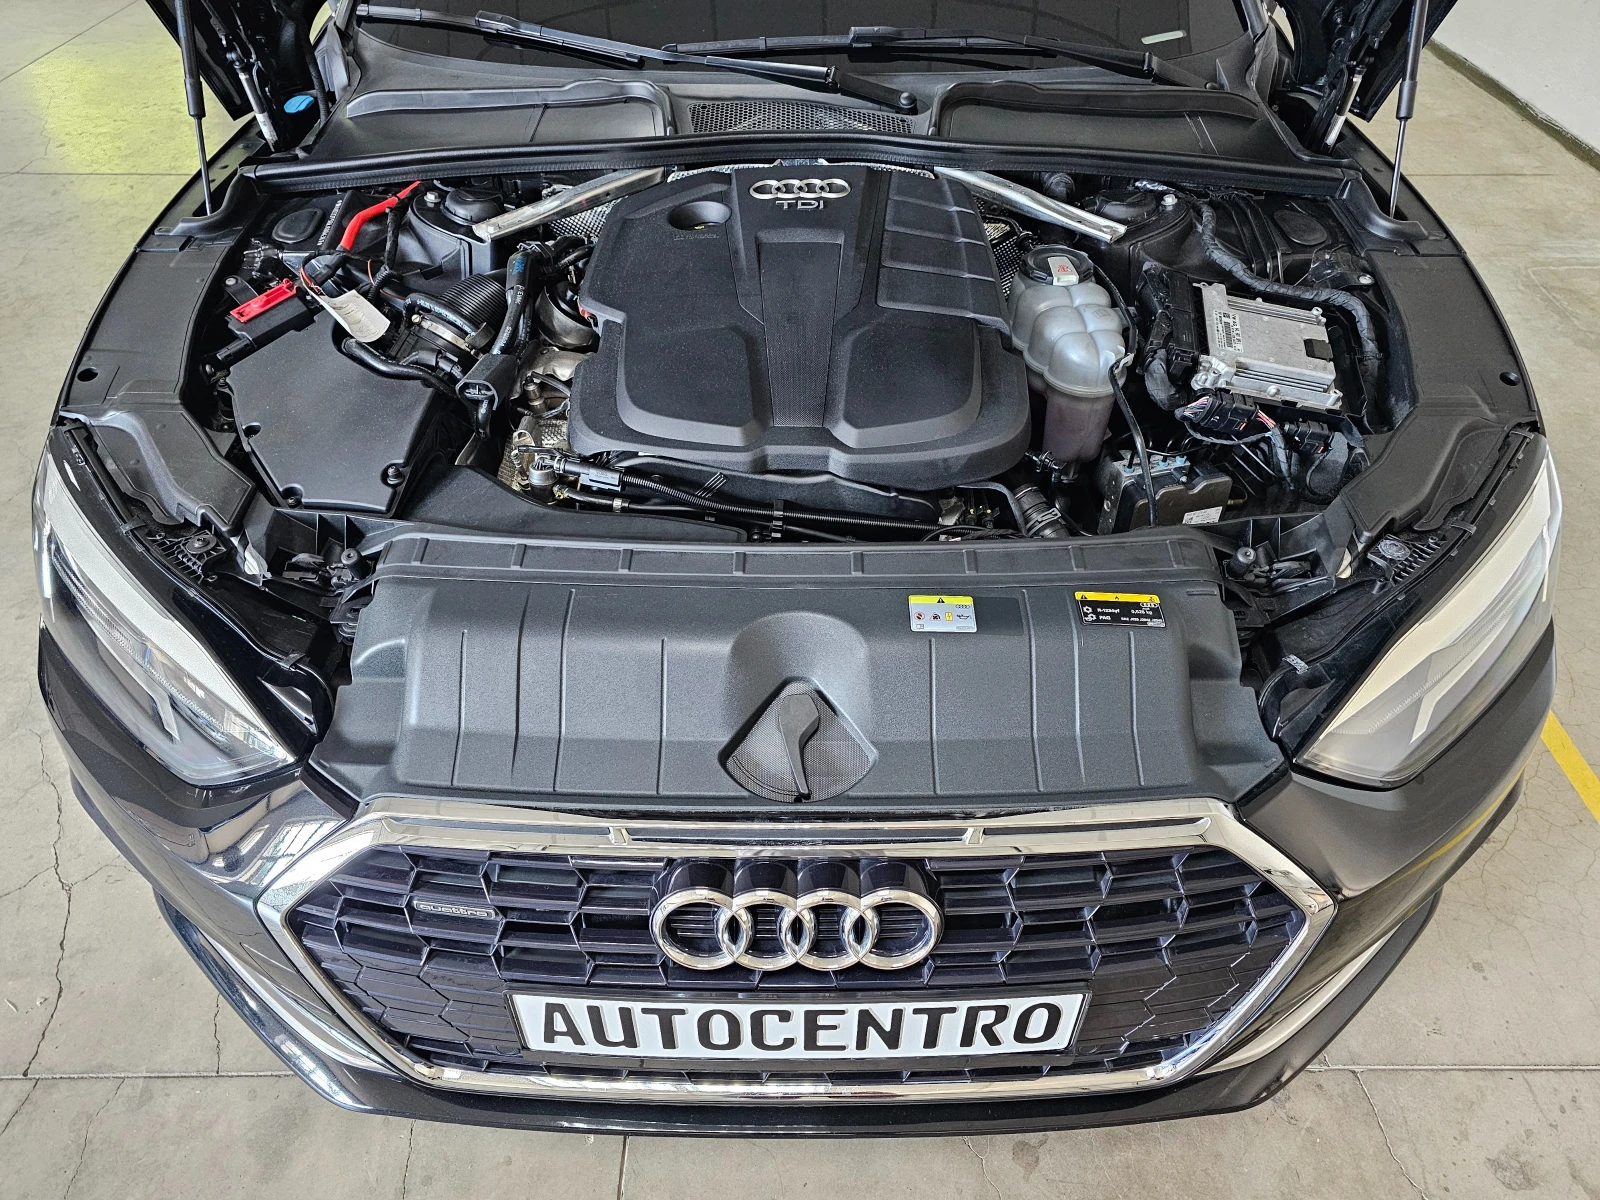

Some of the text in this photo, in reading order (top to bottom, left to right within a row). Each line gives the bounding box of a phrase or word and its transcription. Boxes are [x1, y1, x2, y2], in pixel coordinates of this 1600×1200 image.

[775, 200, 824, 210] TDI
[420, 904, 488, 918] quattro
[542, 1001, 1064, 1052] AUTOCENTRO
